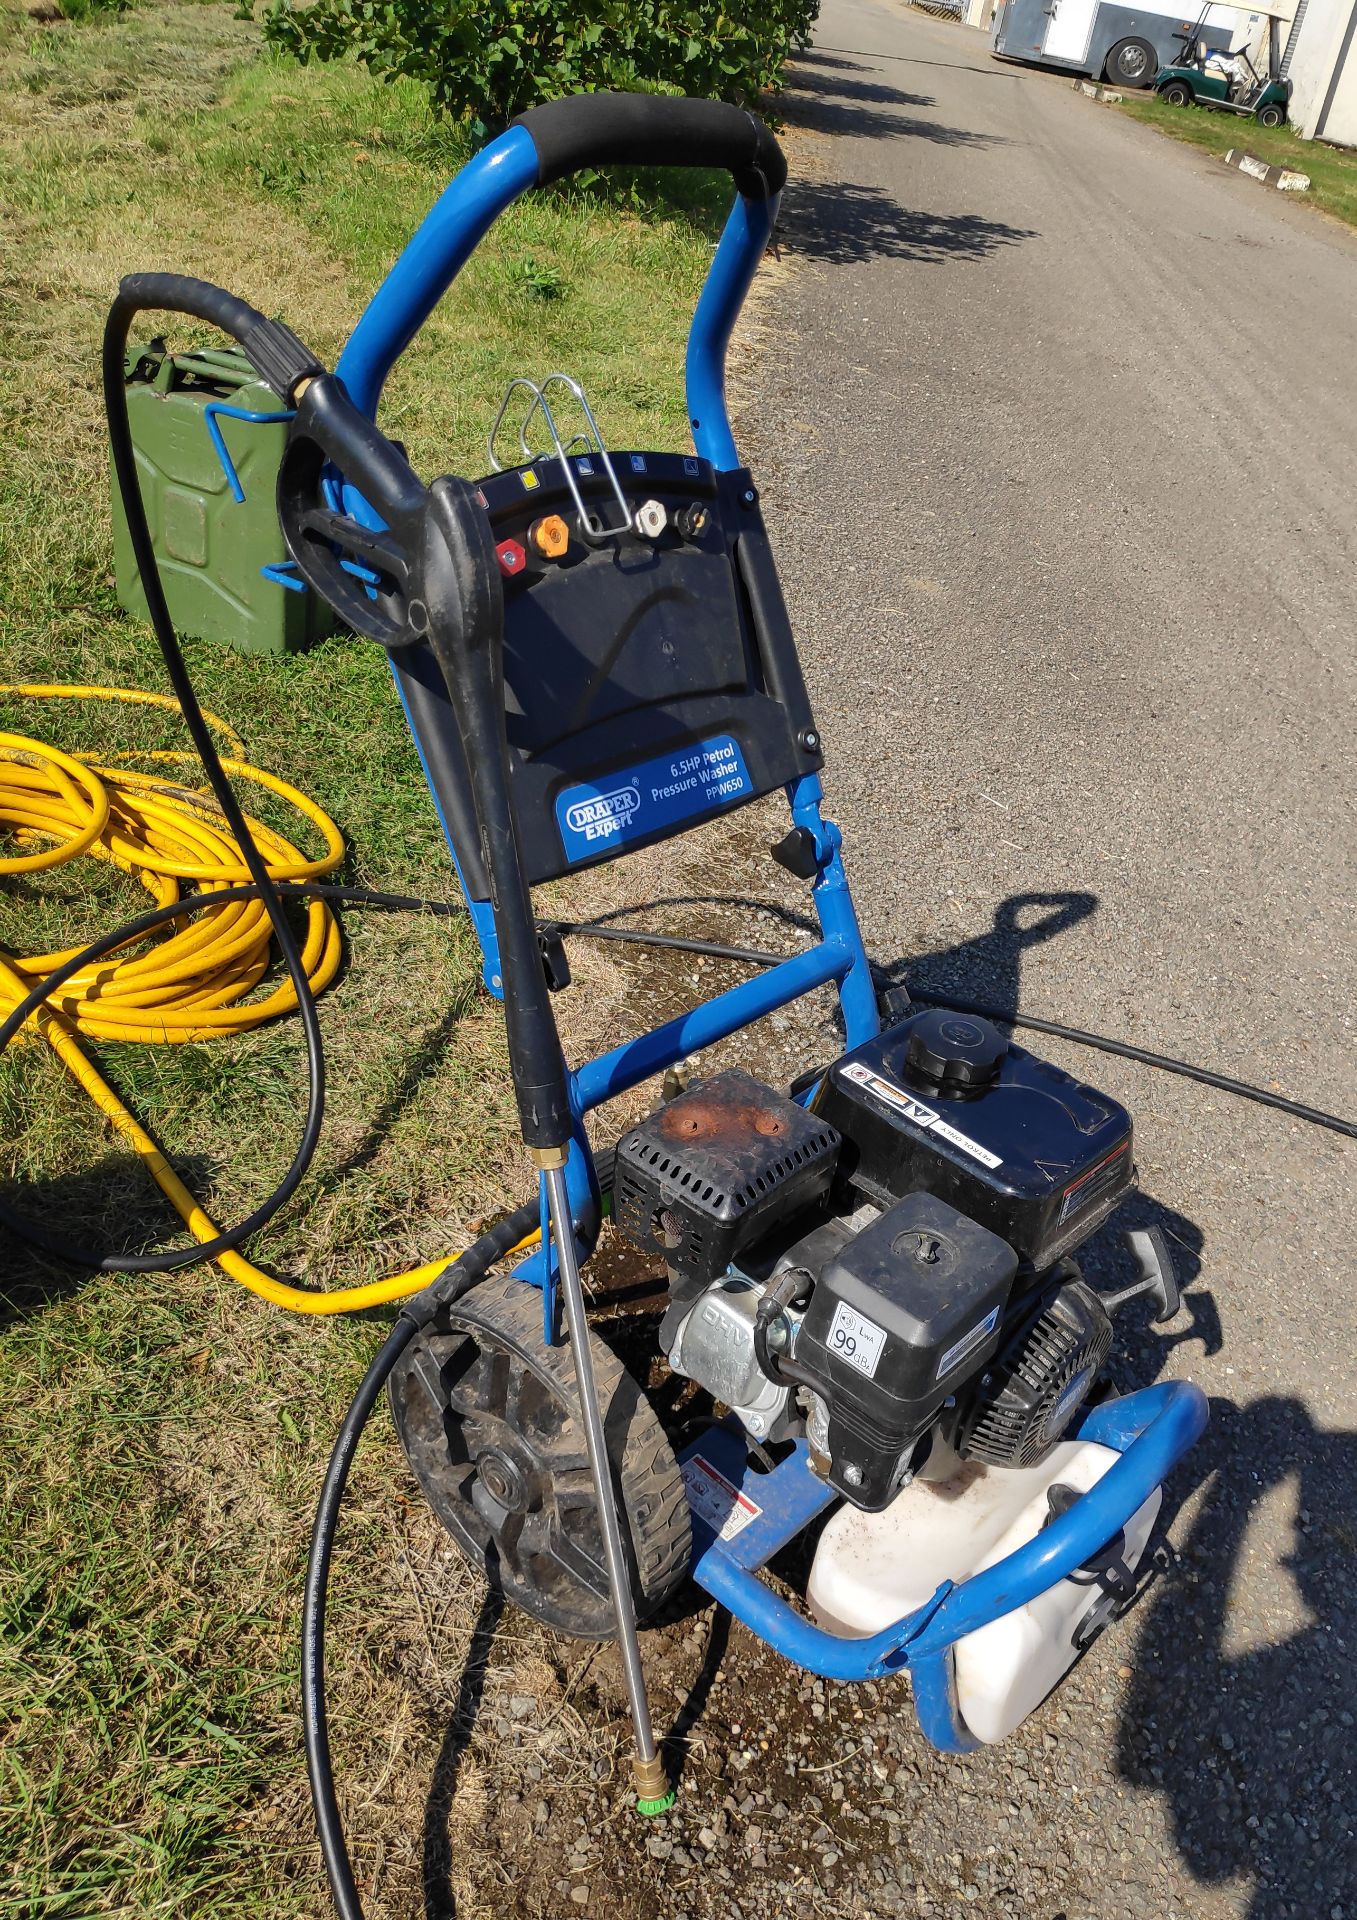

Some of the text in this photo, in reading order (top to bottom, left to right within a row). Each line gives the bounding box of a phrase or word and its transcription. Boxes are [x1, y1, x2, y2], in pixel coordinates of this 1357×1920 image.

[670, 742, 734, 778] 6.5HP Petrol
[651, 760, 739, 802] Pressure Washer
[706, 776, 744, 800] PPW650
[573, 792, 635, 826] DRAPER
[585, 810, 633, 841] Expert
[940, 1126, 993, 1163] PETROL ONLY
[702, 1305, 750, 1346] OHV
[309, 1634, 317, 1652] HOSE
[308, 1655, 316, 1679] WATER
